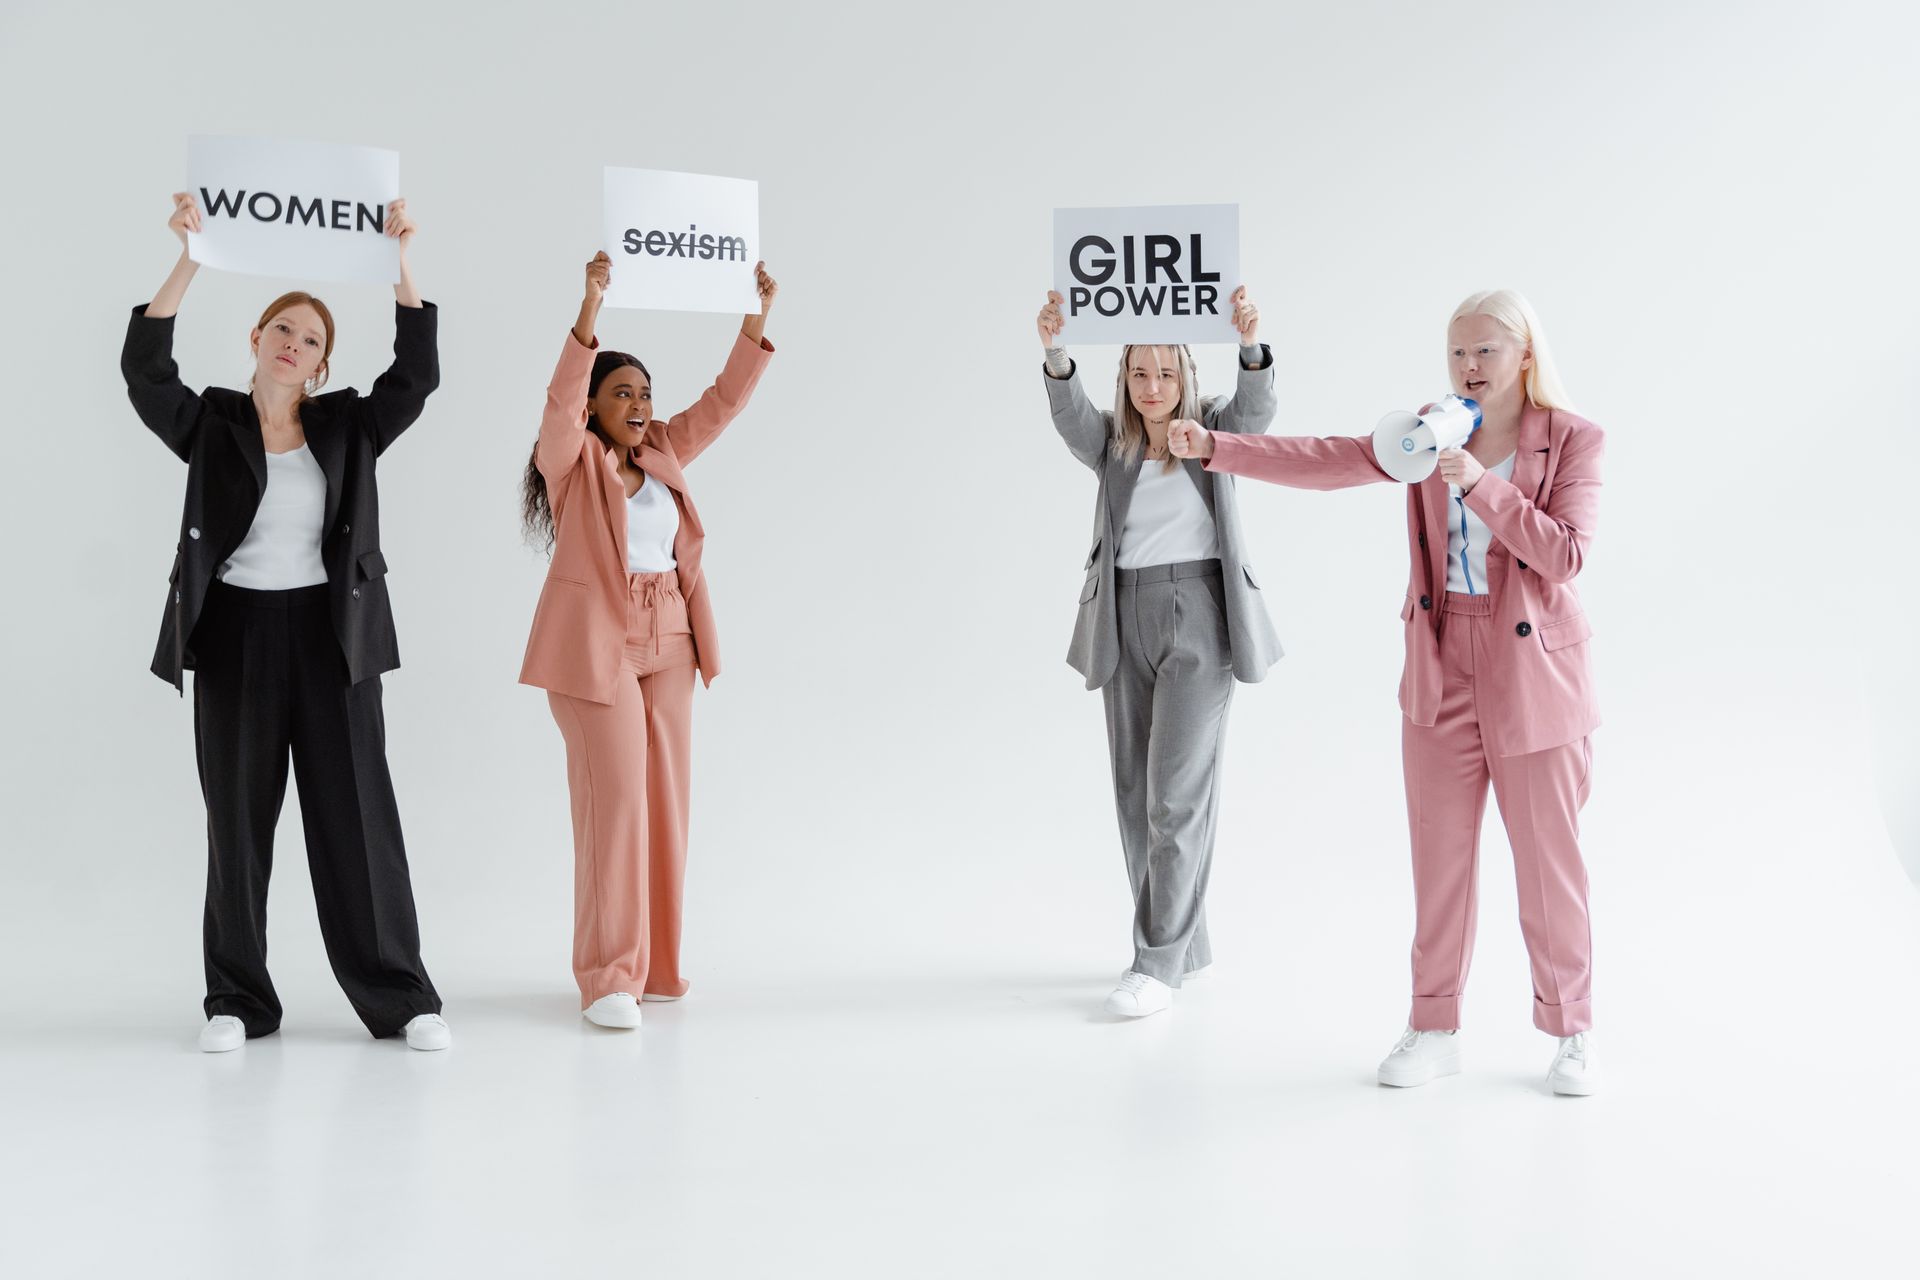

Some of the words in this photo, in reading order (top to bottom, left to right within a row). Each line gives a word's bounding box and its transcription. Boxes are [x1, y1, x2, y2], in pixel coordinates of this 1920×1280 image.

[200, 187, 384, 234] WOMEN
[622, 224, 748, 262] sexism
[1069, 233, 1221, 285] GIRL
[1070, 285, 1219, 317] POWER
